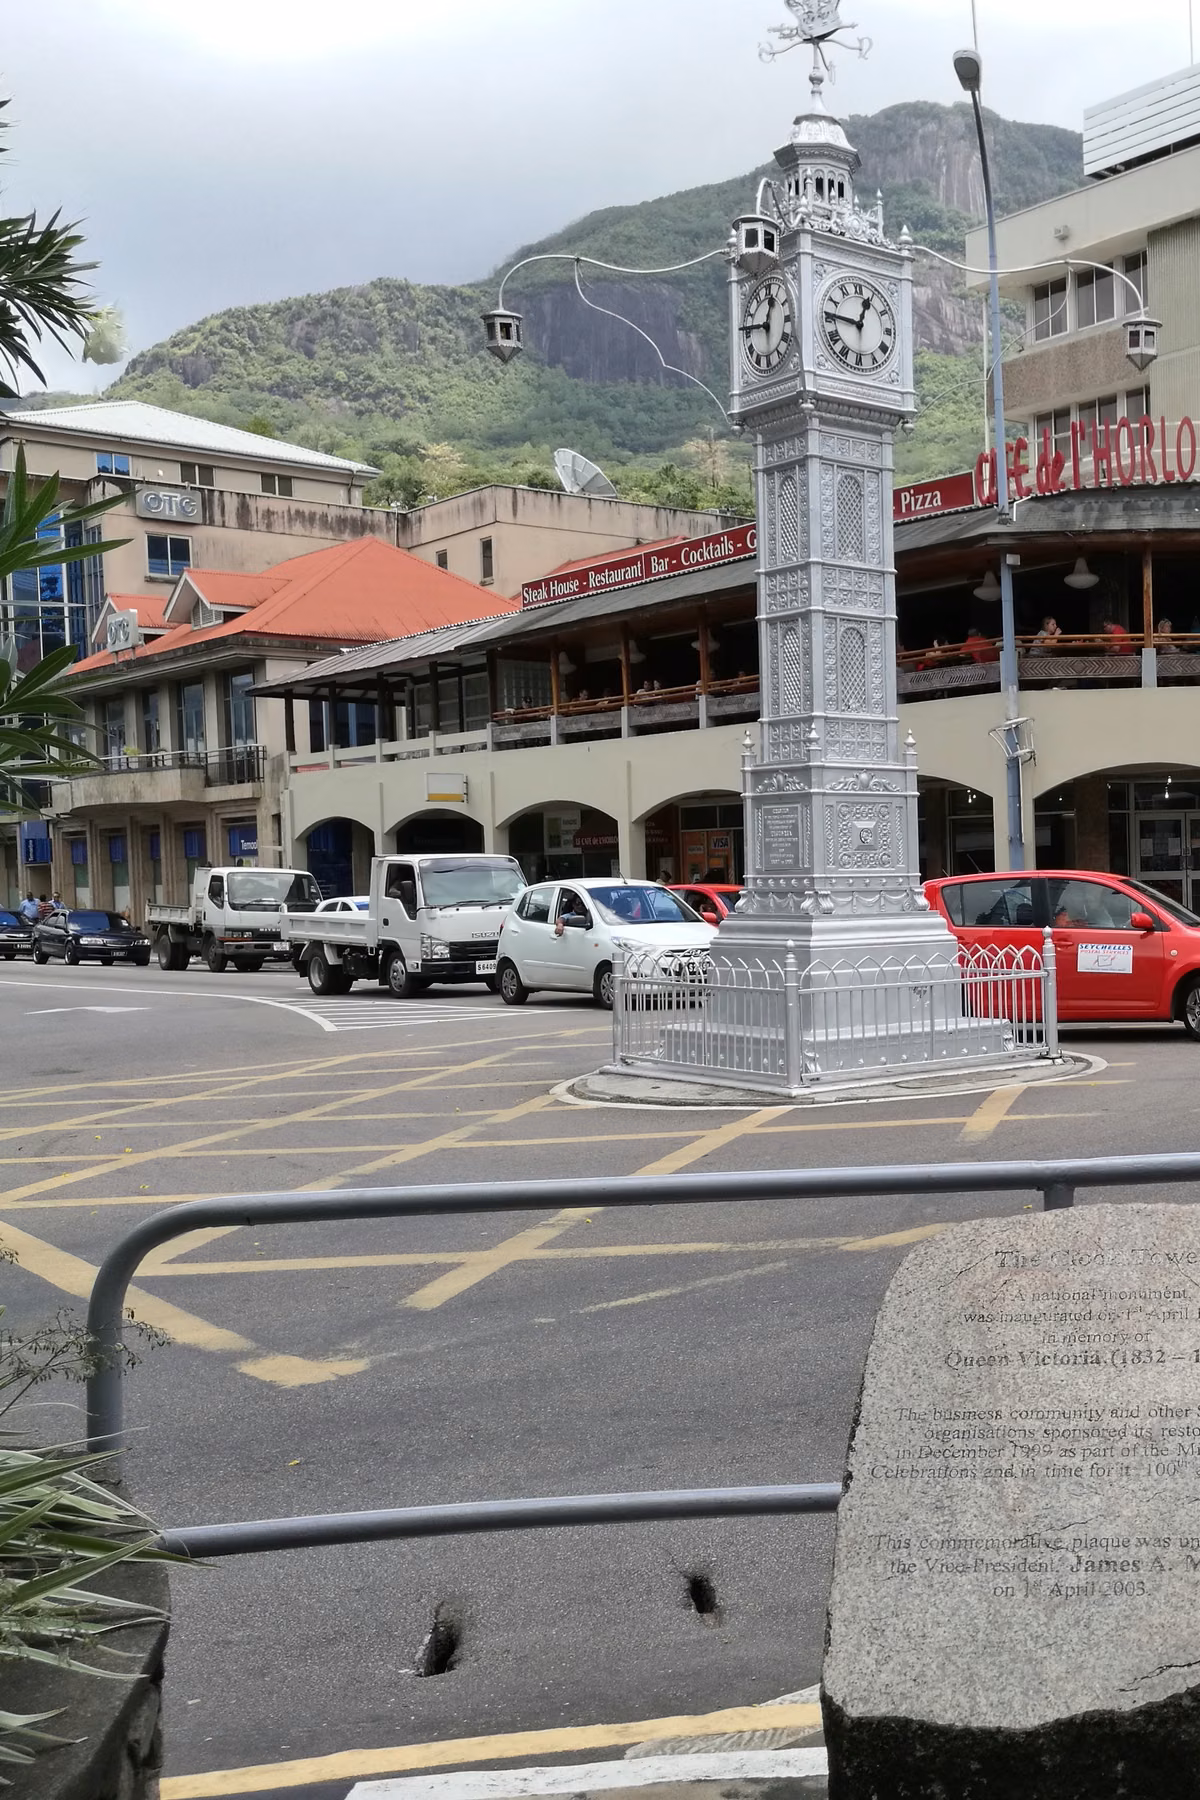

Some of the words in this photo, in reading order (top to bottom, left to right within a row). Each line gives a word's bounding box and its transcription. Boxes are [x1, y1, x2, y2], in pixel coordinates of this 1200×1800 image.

[142, 490, 198, 517] OTC
[901, 488, 942, 513] Pizza
[651, 556, 669, 574] Bar
[681, 535, 734, 566] Cocktails
[523, 582, 549, 604] Steak
[550, 579, 579, 598] House
[588, 561, 642, 588] Restaurant
[107, 617, 130, 646] OTC
[712, 837, 729, 848] VISA
[471, 931, 501, 939] ISUZU
[995, 1250, 1041, 1267] The
[1032, 1289, 1096, 1301] national
[964, 1313, 994, 1323] was
[1000, 1309, 1093, 1325] inaugurated
[1149, 1307, 1189, 1323] April
[1062, 1332, 1128, 1345] memory
[1134, 1329, 1153, 1343] of
[945, 1351, 1009, 1370] Queen
[895, 1407, 927, 1421] The
[933, 1407, 1003, 1421] business
[1010, 1405, 1105, 1422] community
[1110, 1405, 1140, 1419] and
[1148, 1404, 1191, 1419] other
[924, 1424, 1036, 1443] organisations
[1042, 1424, 1127, 1442] sponsored
[1134, 1423, 1153, 1438] its
[896, 1445, 912, 1459] in
[918, 1444, 1004, 1459] December
[1011, 1442, 1053, 1459] 1999
[1059, 1447, 1076, 1458] as
[1082, 1445, 1115, 1461] part
[1121, 1443, 1139, 1457] of
[1144, 1443, 1169, 1457] the
[870, 1463, 977, 1479] Celebrations
[983, 1464, 1015, 1479] and
[1020, 1465, 1036, 1478] in
[1045, 1463, 1083, 1478] time
[1089, 1462, 1112, 1477] for
[872, 1534, 911, 1549] This
[919, 1535, 1063, 1550] commemorative
[1072, 1533, 1130, 1552] plaque
[1135, 1536, 1171, 1549] was
[890, 1560, 917, 1574] the
[1070, 1554, 1141, 1573] James
[1149, 1555, 1173, 1572] A.
[993, 1584, 1015, 1597] on
[1049, 1581, 1095, 1600] April
